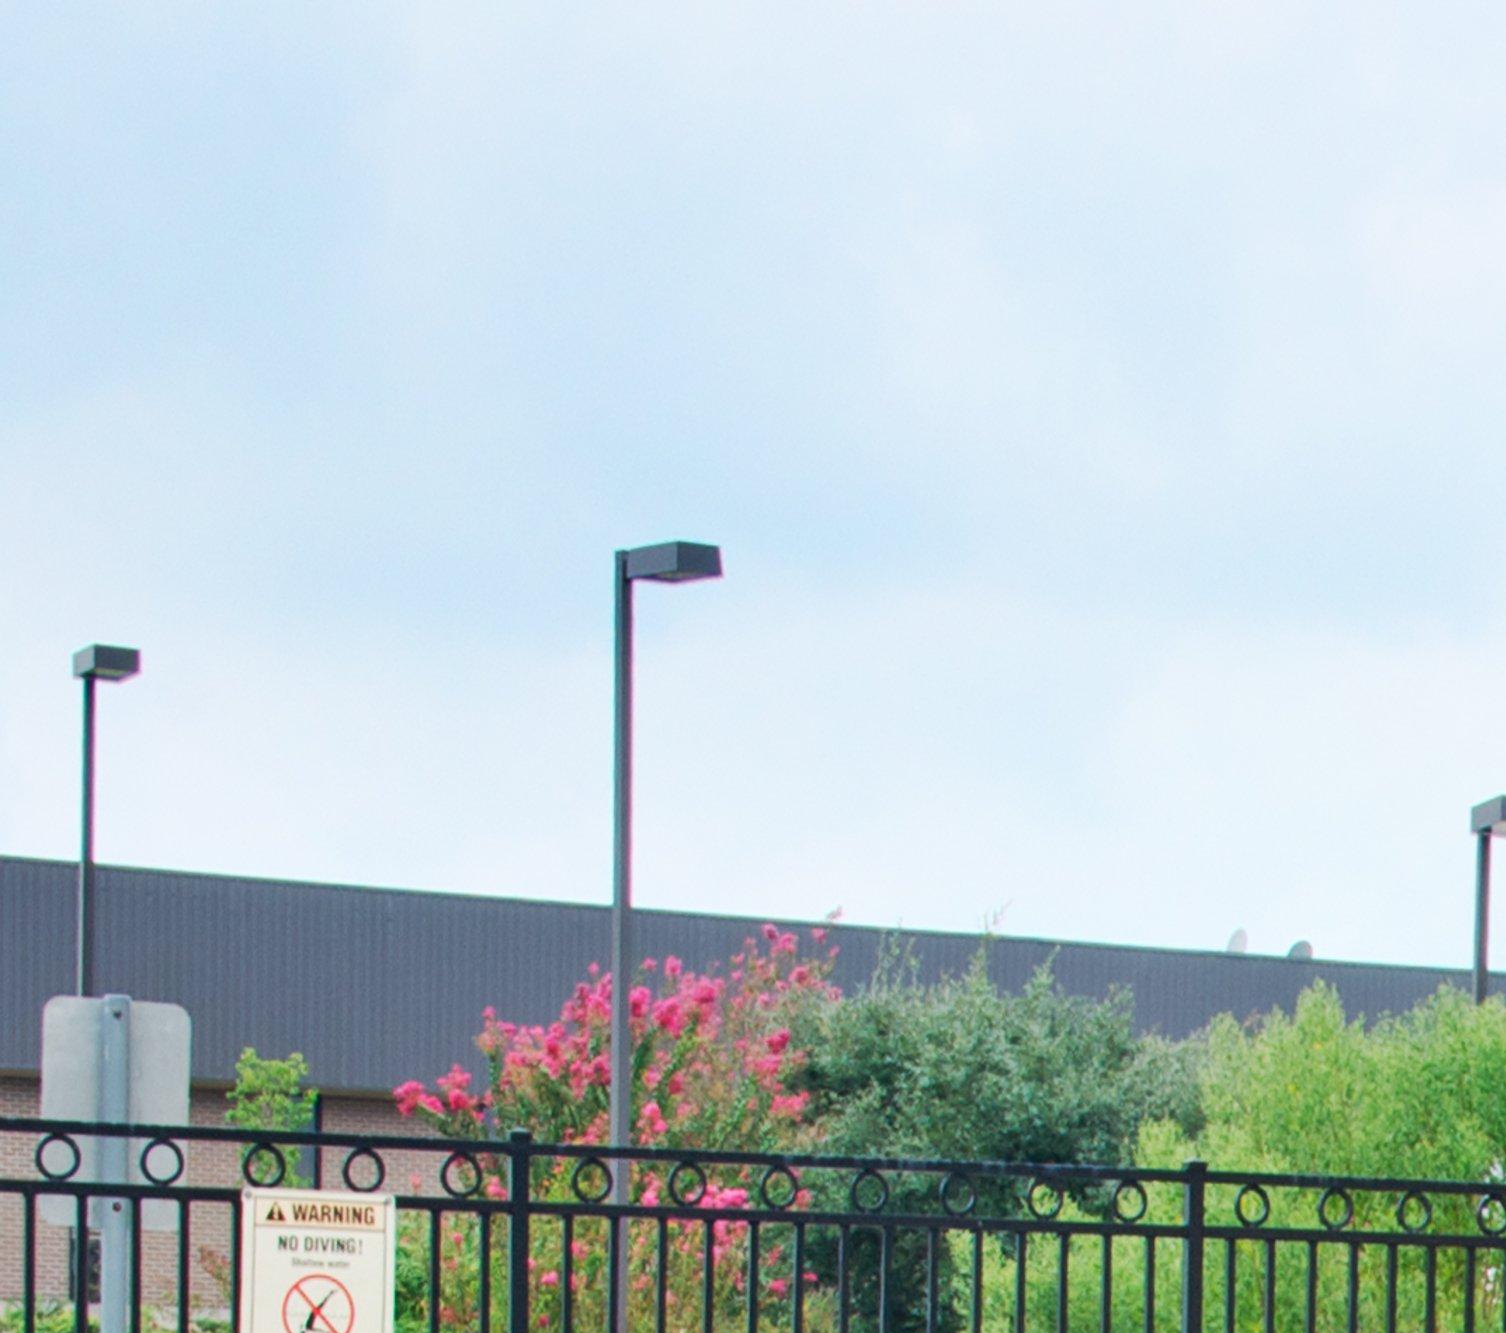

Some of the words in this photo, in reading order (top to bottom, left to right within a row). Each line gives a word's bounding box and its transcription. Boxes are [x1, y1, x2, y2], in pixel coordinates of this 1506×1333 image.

[292, 1204, 375, 1225] WARNING
[277, 1235, 298, 1251] NO
[304, 1236, 363, 1254] DIVING!
